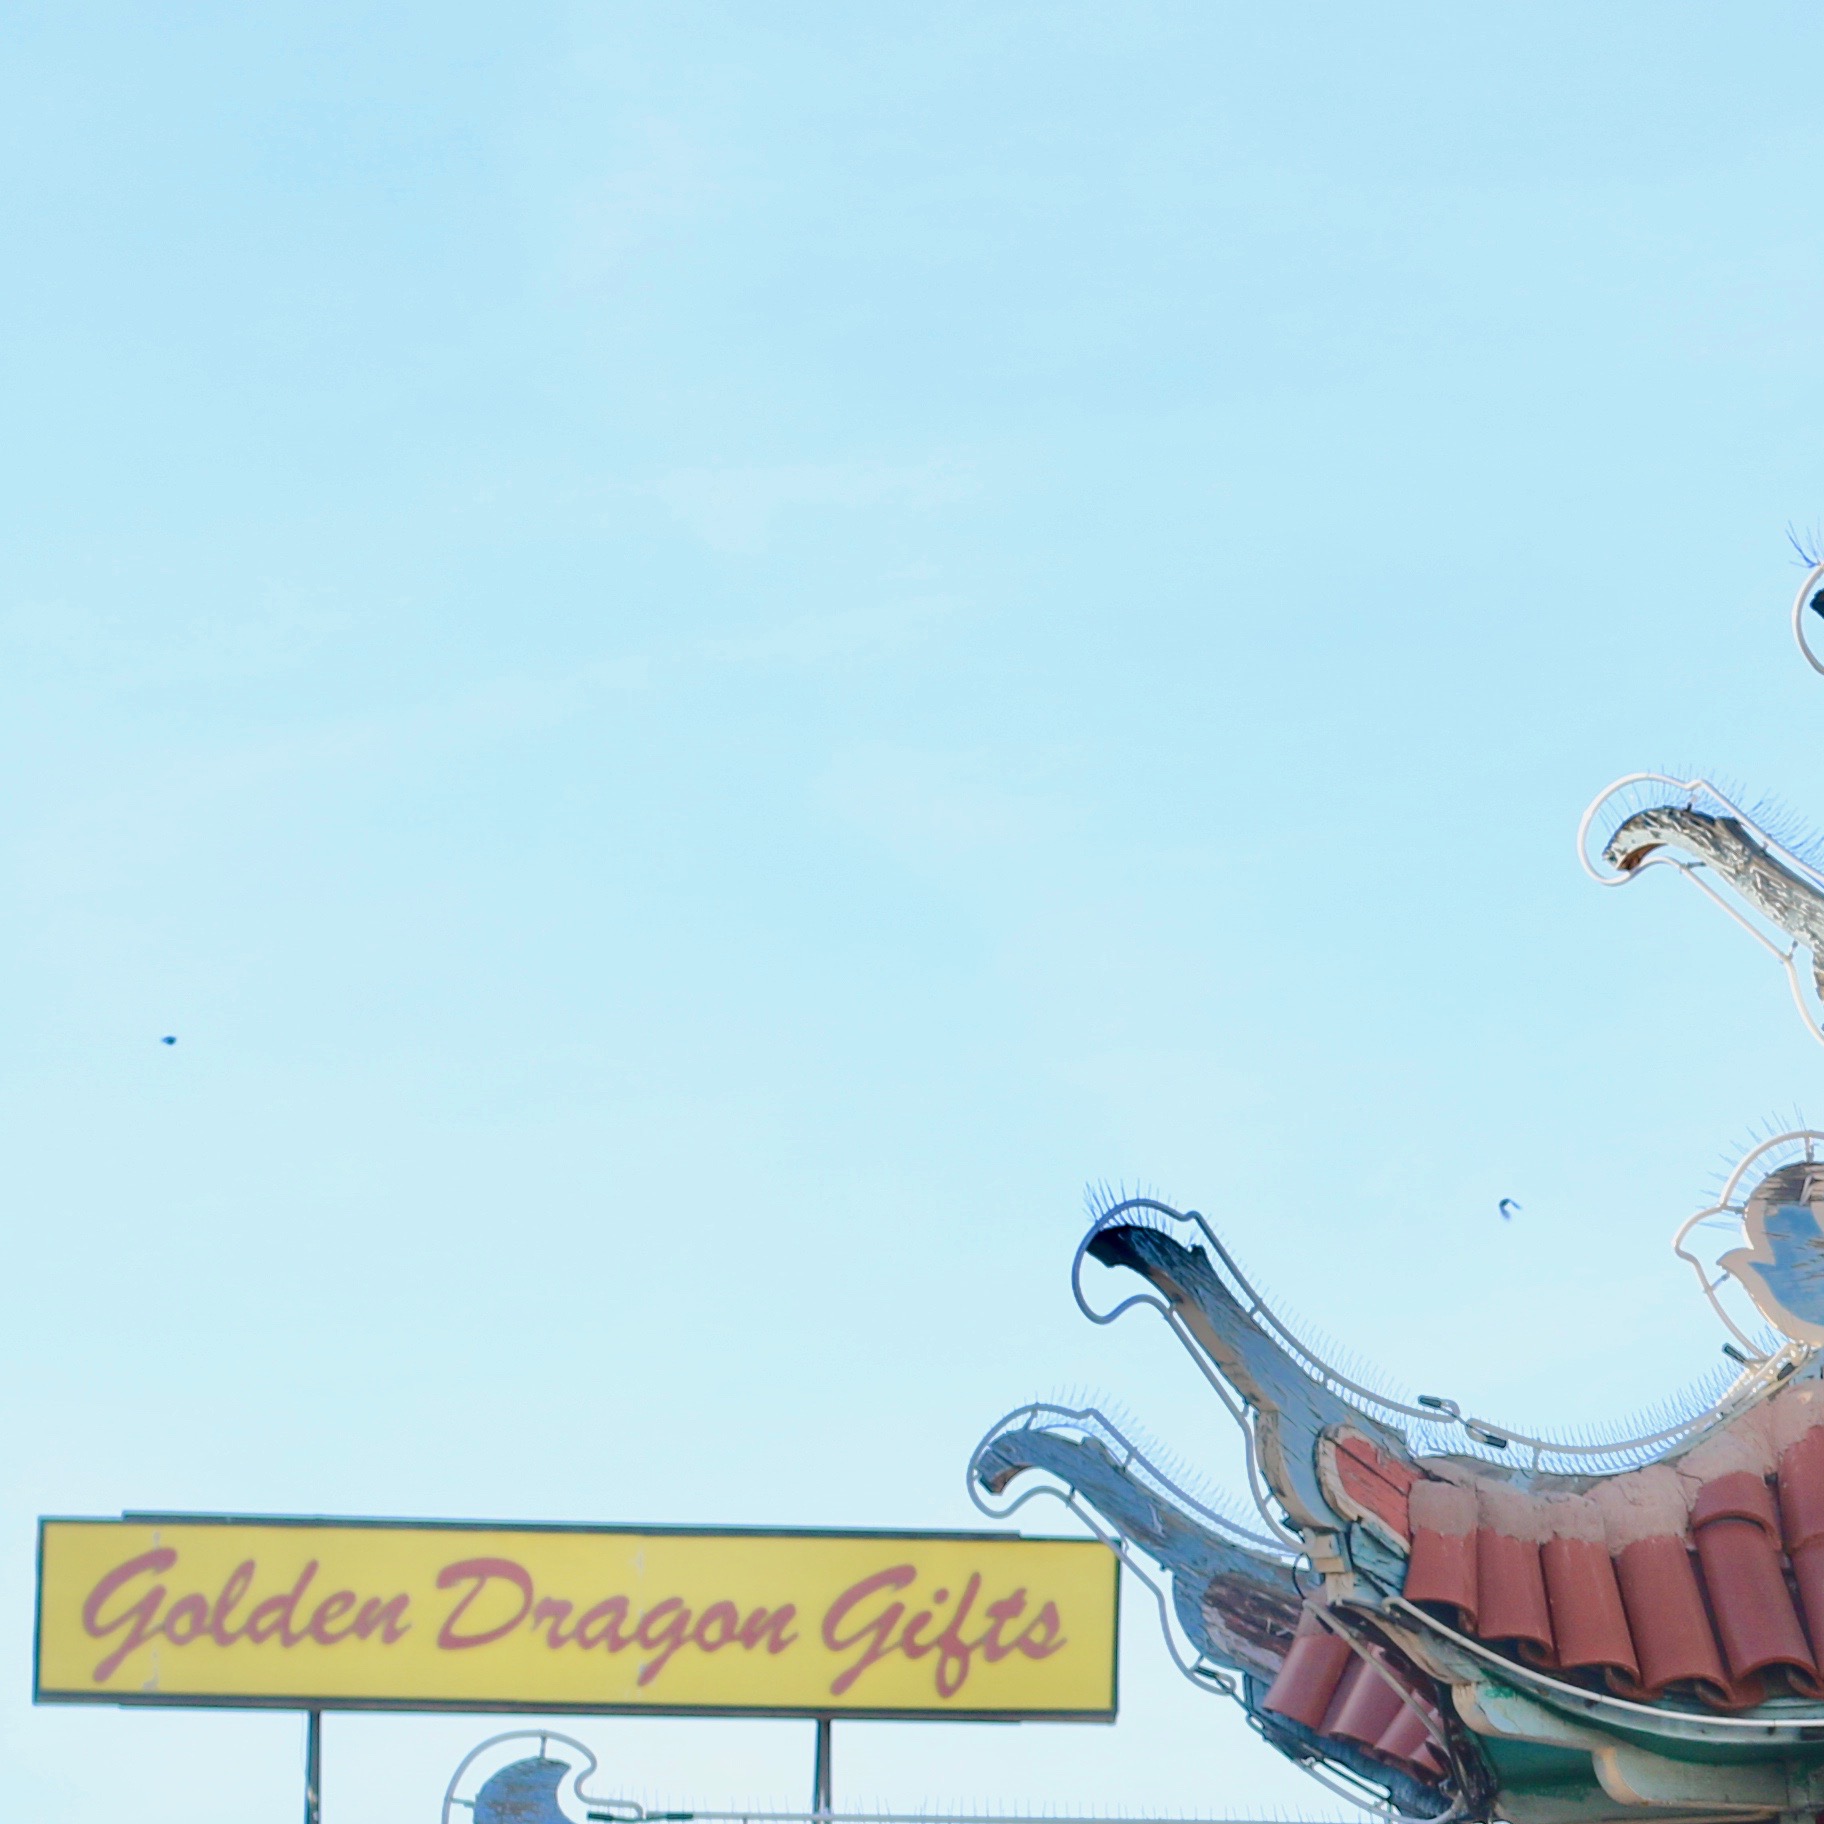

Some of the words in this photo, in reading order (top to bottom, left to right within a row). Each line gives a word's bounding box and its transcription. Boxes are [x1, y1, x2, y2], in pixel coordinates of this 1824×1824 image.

[87, 1549, 411, 1682] Golden
[437, 1558, 798, 1687] Dragon
[823, 1566, 1067, 1698] Gifts
